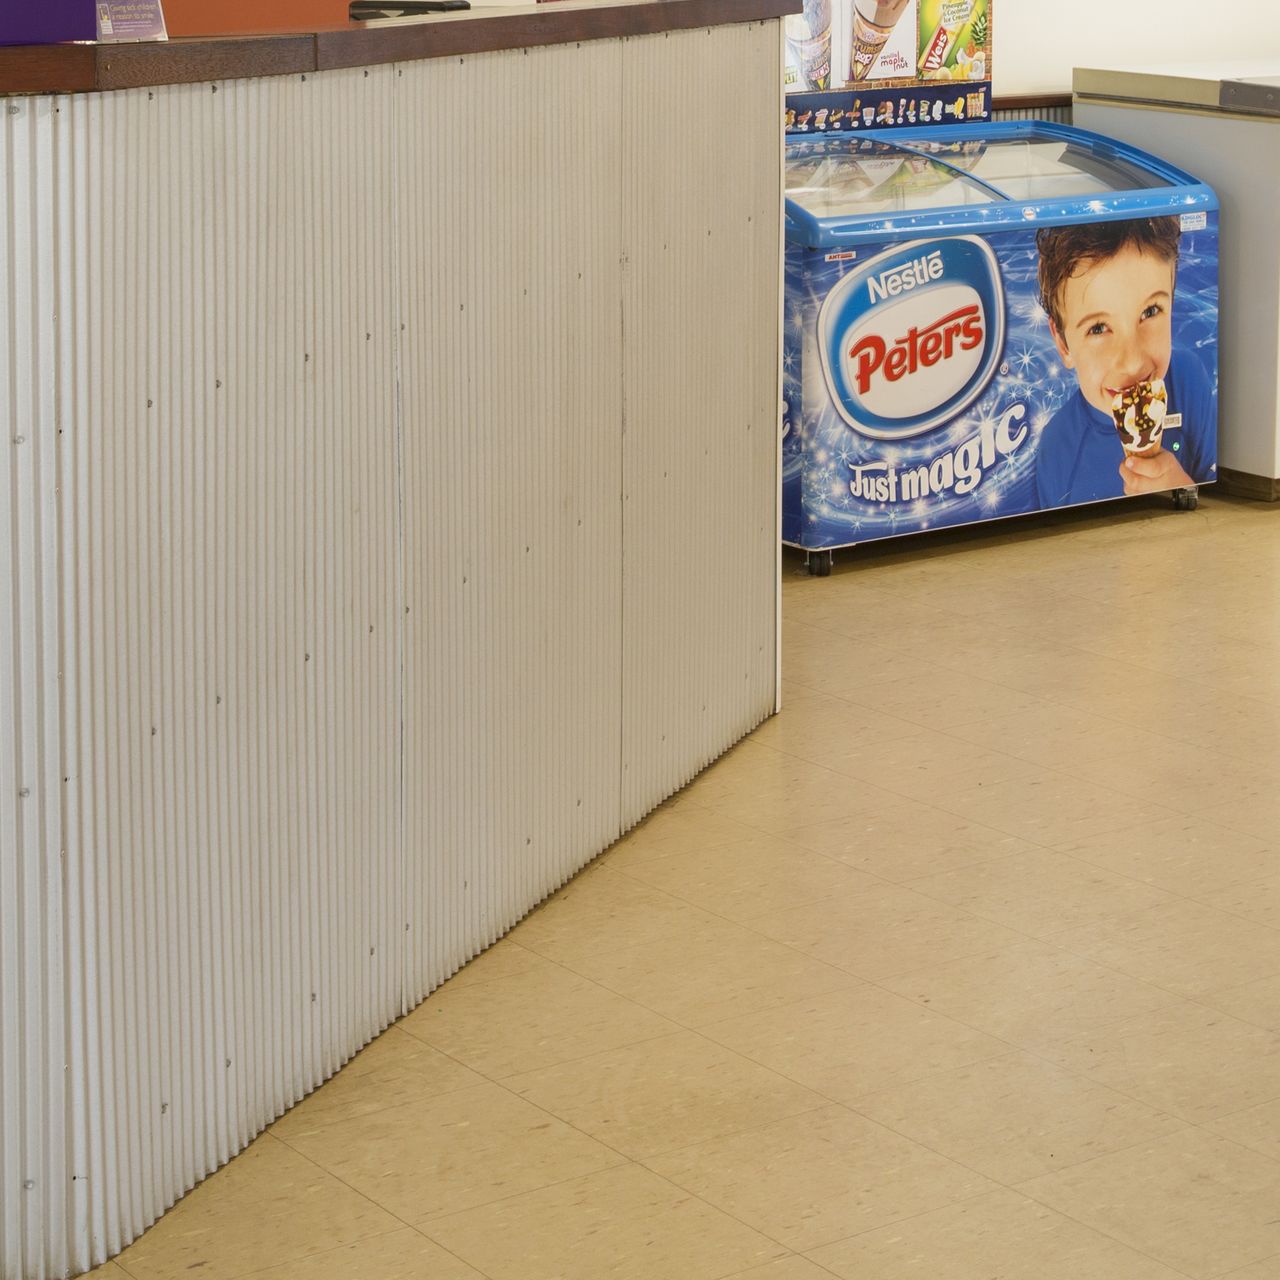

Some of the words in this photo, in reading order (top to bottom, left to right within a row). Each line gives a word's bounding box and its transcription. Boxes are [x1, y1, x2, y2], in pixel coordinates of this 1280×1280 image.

[951, 13, 970, 23] Cream
[880, 51, 904, 72] maple
[895, 62, 909, 70] nut
[925, 29, 948, 70] Weis
[866, 249, 945, 305] Nestlé
[848, 304, 984, 396] Peters
[848, 461, 898, 503] Just
[901, 403, 1028, 502] magic
